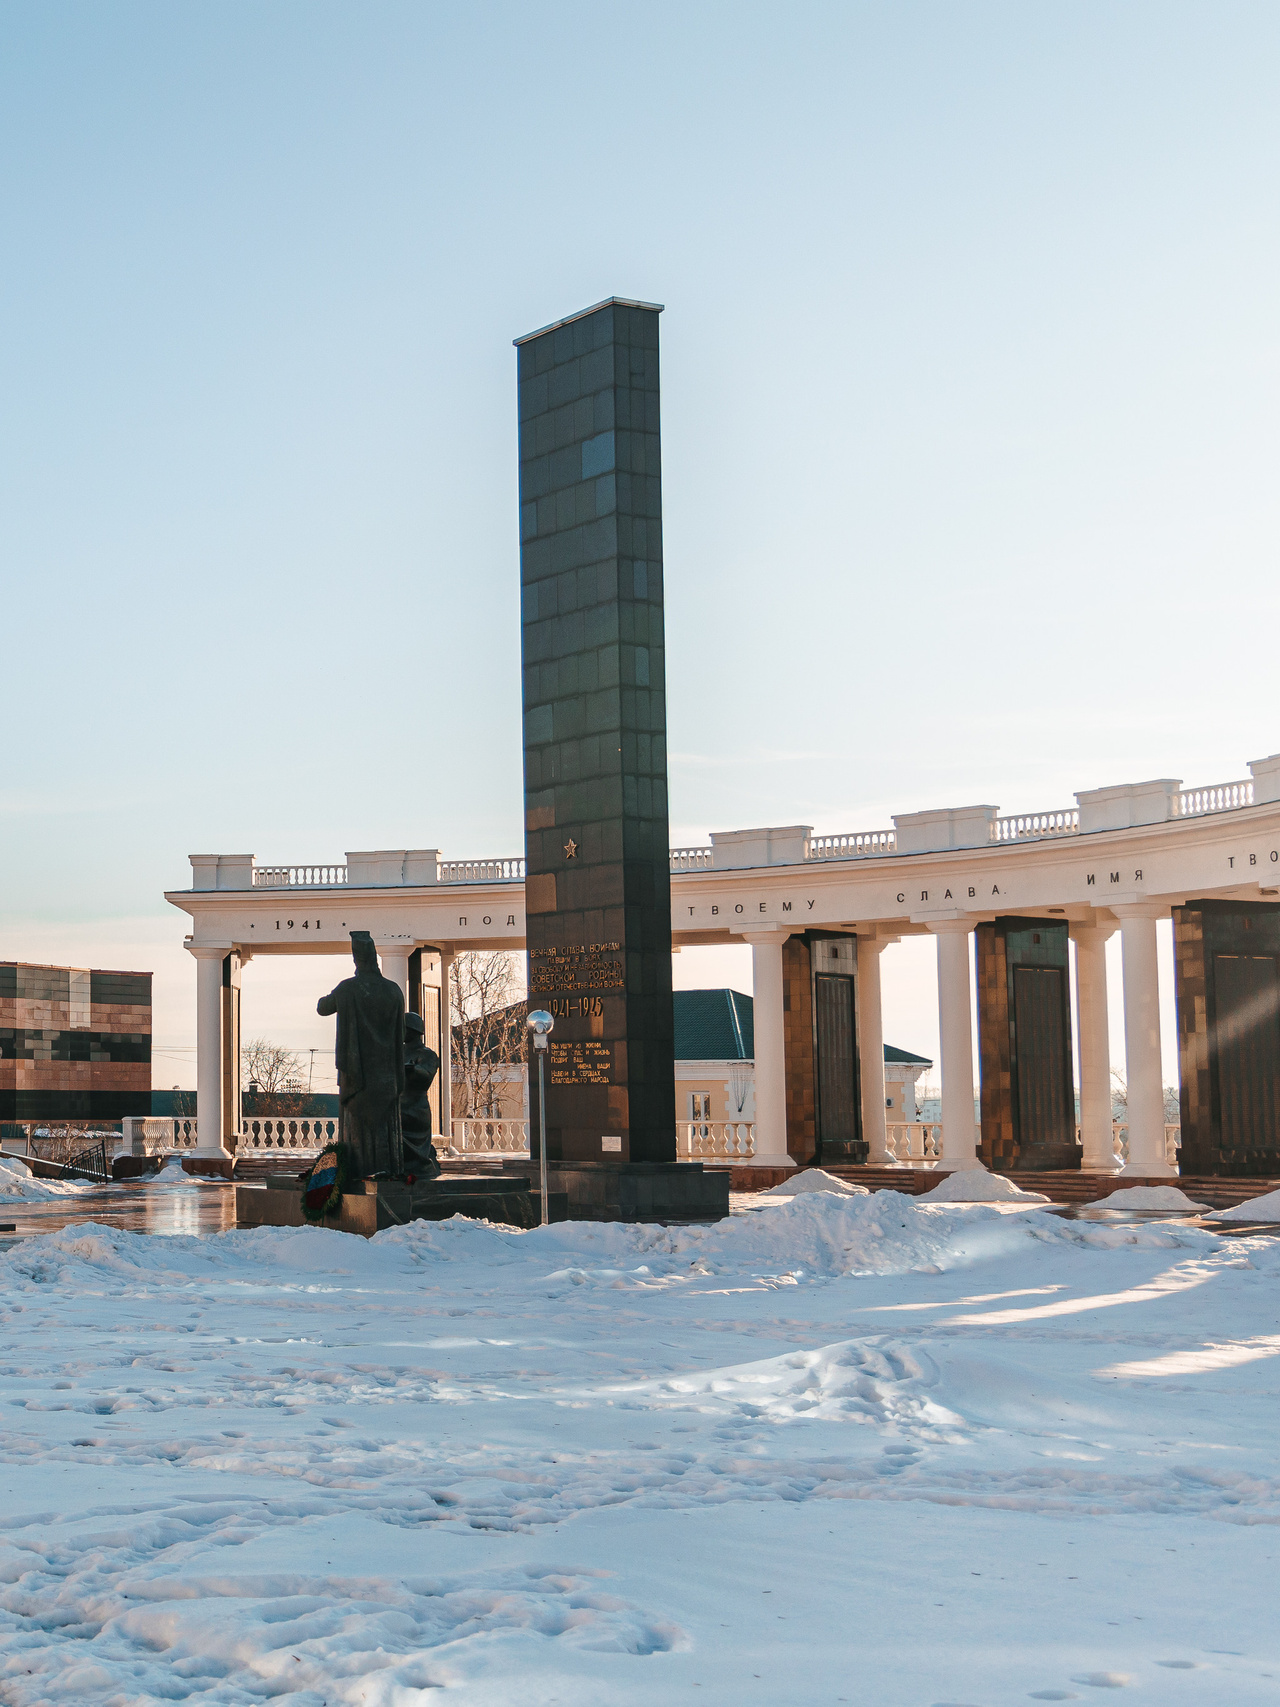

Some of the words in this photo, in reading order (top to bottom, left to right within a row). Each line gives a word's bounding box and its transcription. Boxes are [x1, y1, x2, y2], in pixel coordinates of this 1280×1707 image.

[687, 899, 815, 916] ТВОЕМУ
[1087, 869, 1144, 885] ИМЯ
[1227, 850, 1279, 869] ТВО
[275, 919, 322, 930] 1941
[530, 947, 557, 958] ВЕЧНАЯ
[561, 945, 585, 955] СЛАВА
[589, 942, 621, 953] ВОИНАМ
[588, 969, 623, 980] РОДИНЫ
